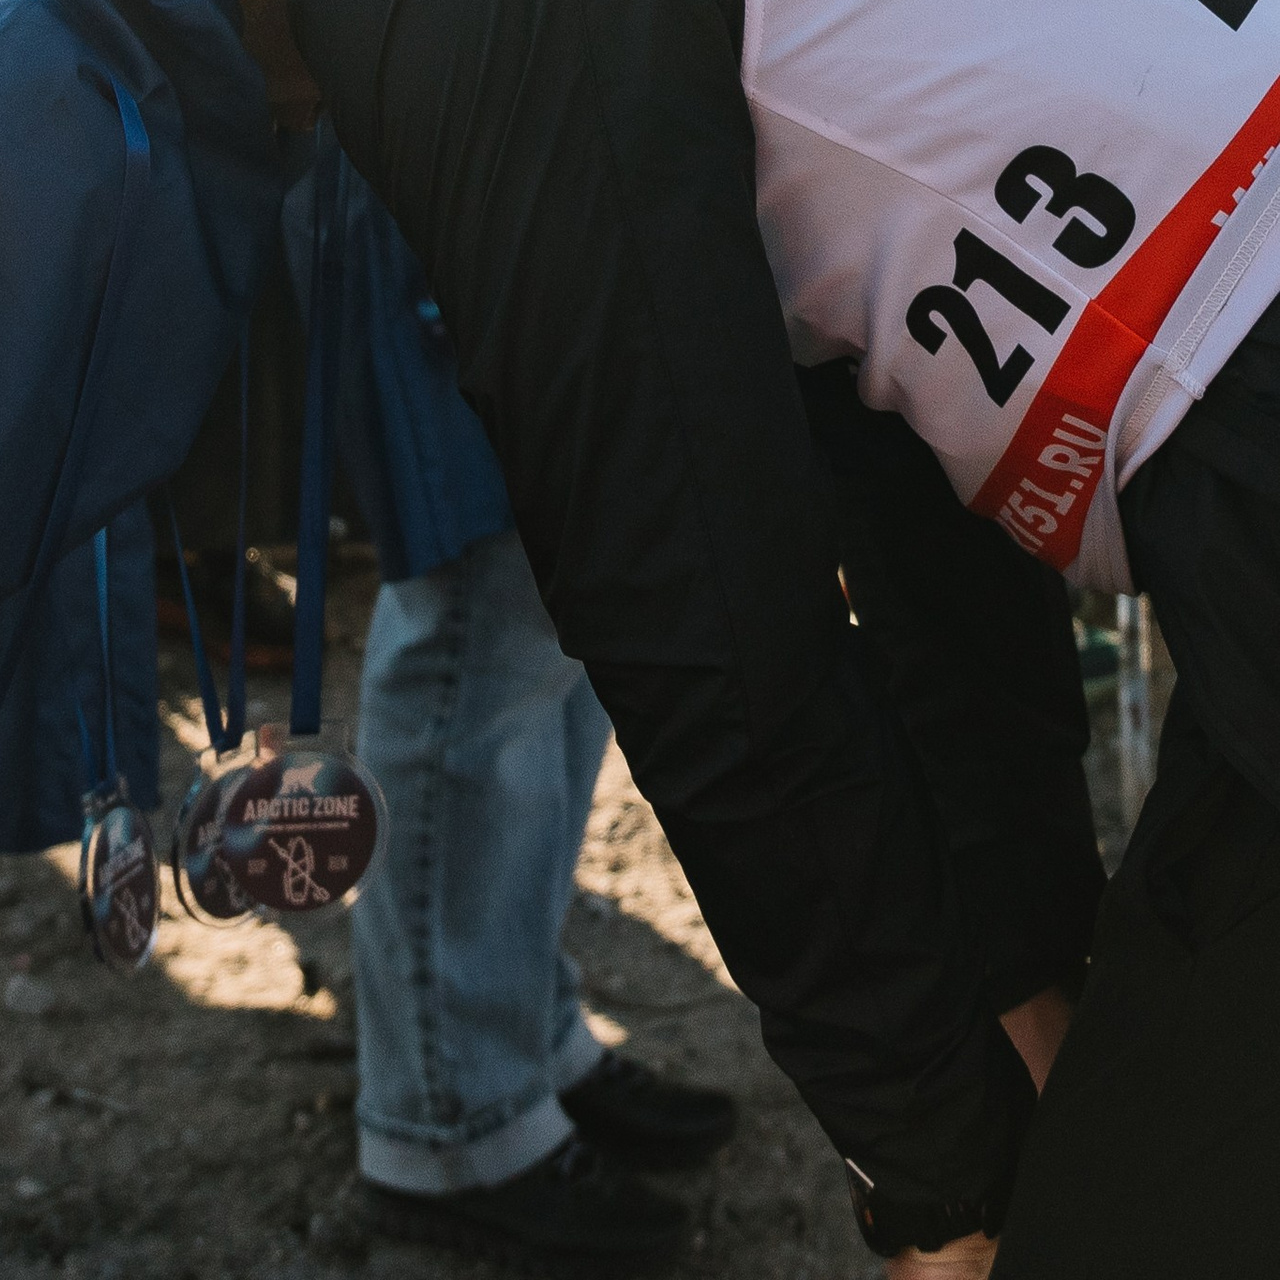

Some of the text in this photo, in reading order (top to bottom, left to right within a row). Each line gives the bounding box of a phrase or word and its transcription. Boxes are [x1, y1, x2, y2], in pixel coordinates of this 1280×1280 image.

[905, 145, 1137, 409] 213
[243, 794, 360, 822] ARCTIC ZONE
